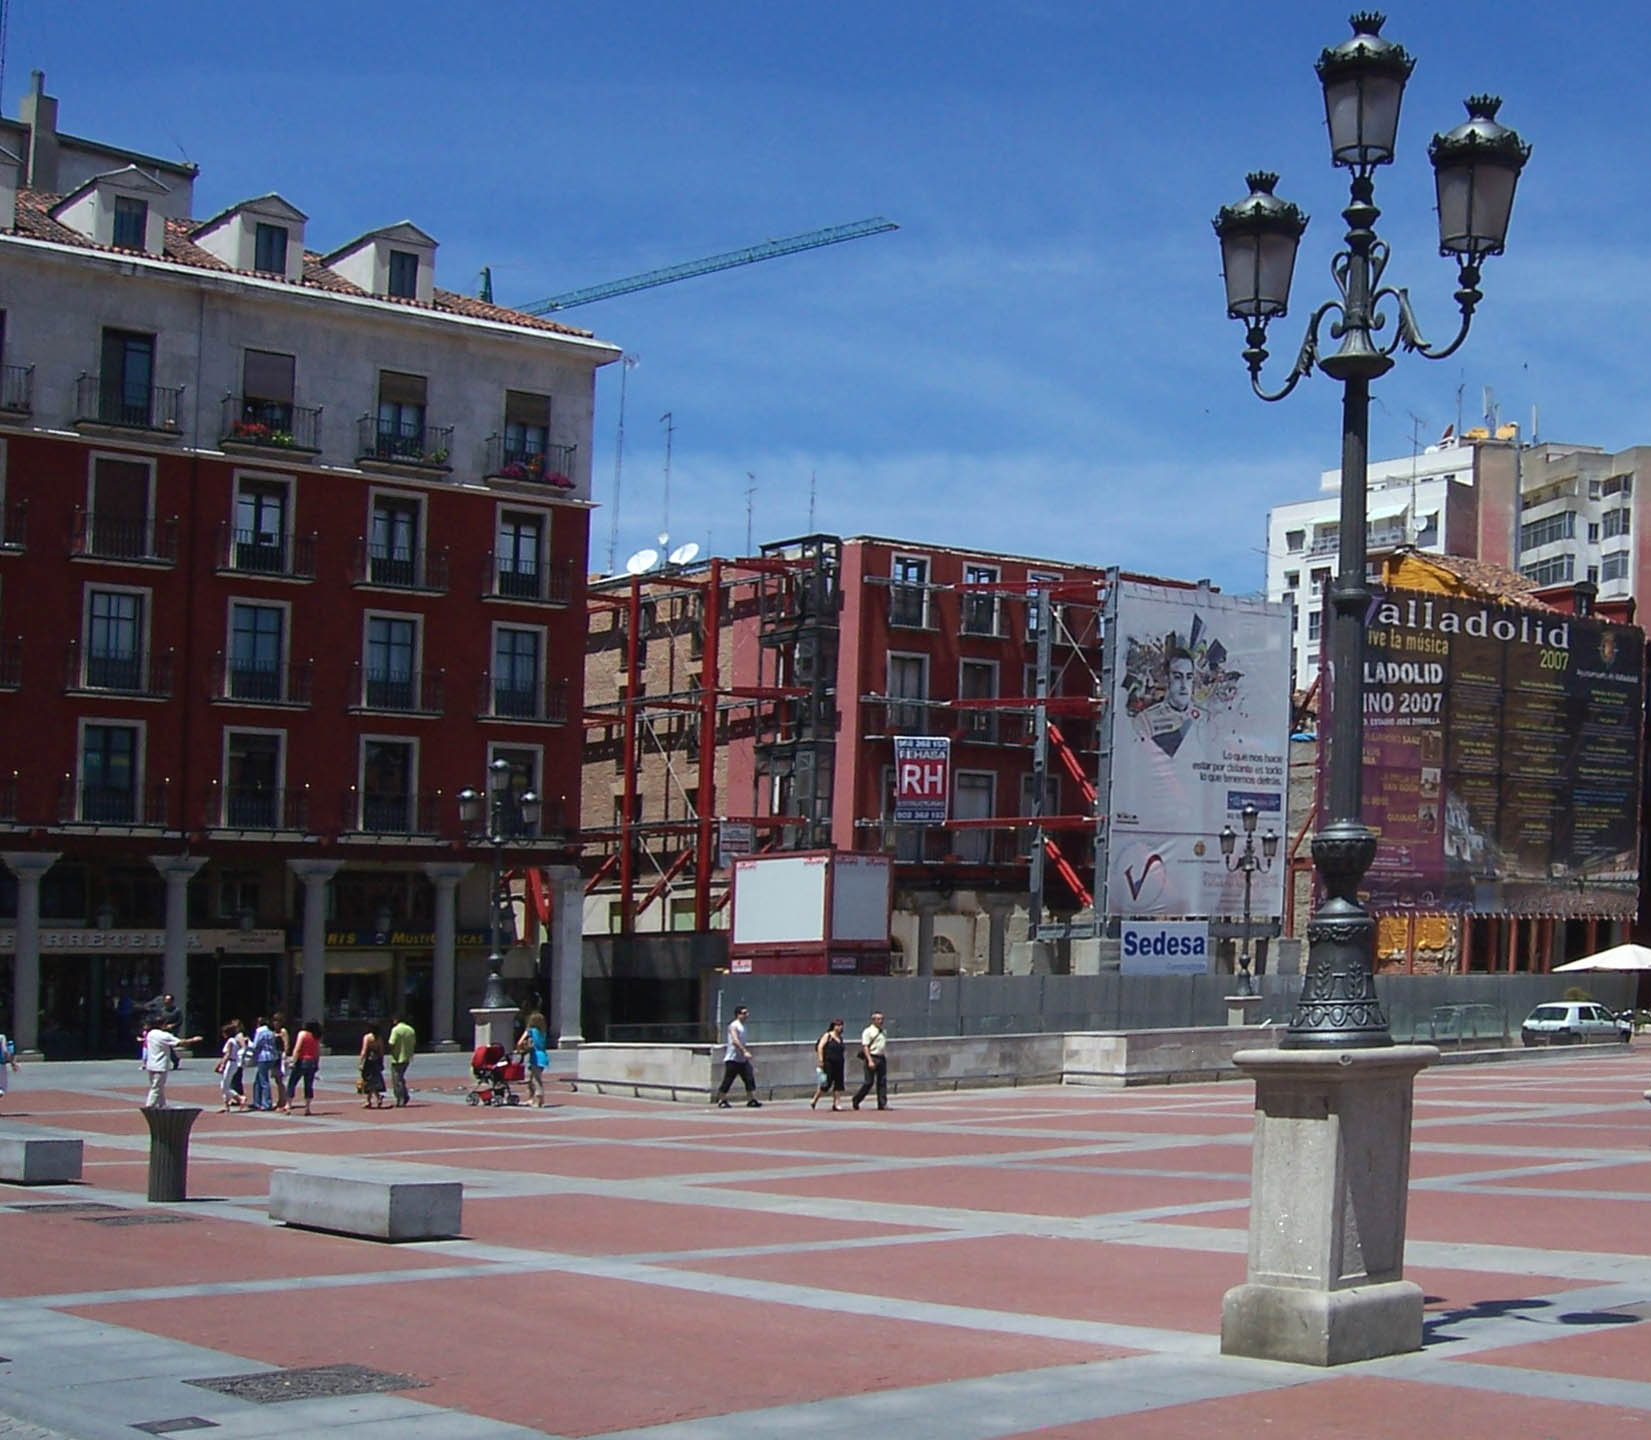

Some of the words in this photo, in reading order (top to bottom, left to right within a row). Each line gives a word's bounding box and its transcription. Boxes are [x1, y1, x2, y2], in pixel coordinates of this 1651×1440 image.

[1406, 636, 1449, 655] música
[1539, 649, 1569, 671] 2007
[1399, 692, 1443, 714] 2007
[1233, 752, 1247, 762] que
[901, 764, 944, 795] RH
[0, 932, 202, 949] FRRETERA
[1124, 931, 1205, 956] Sedesa
